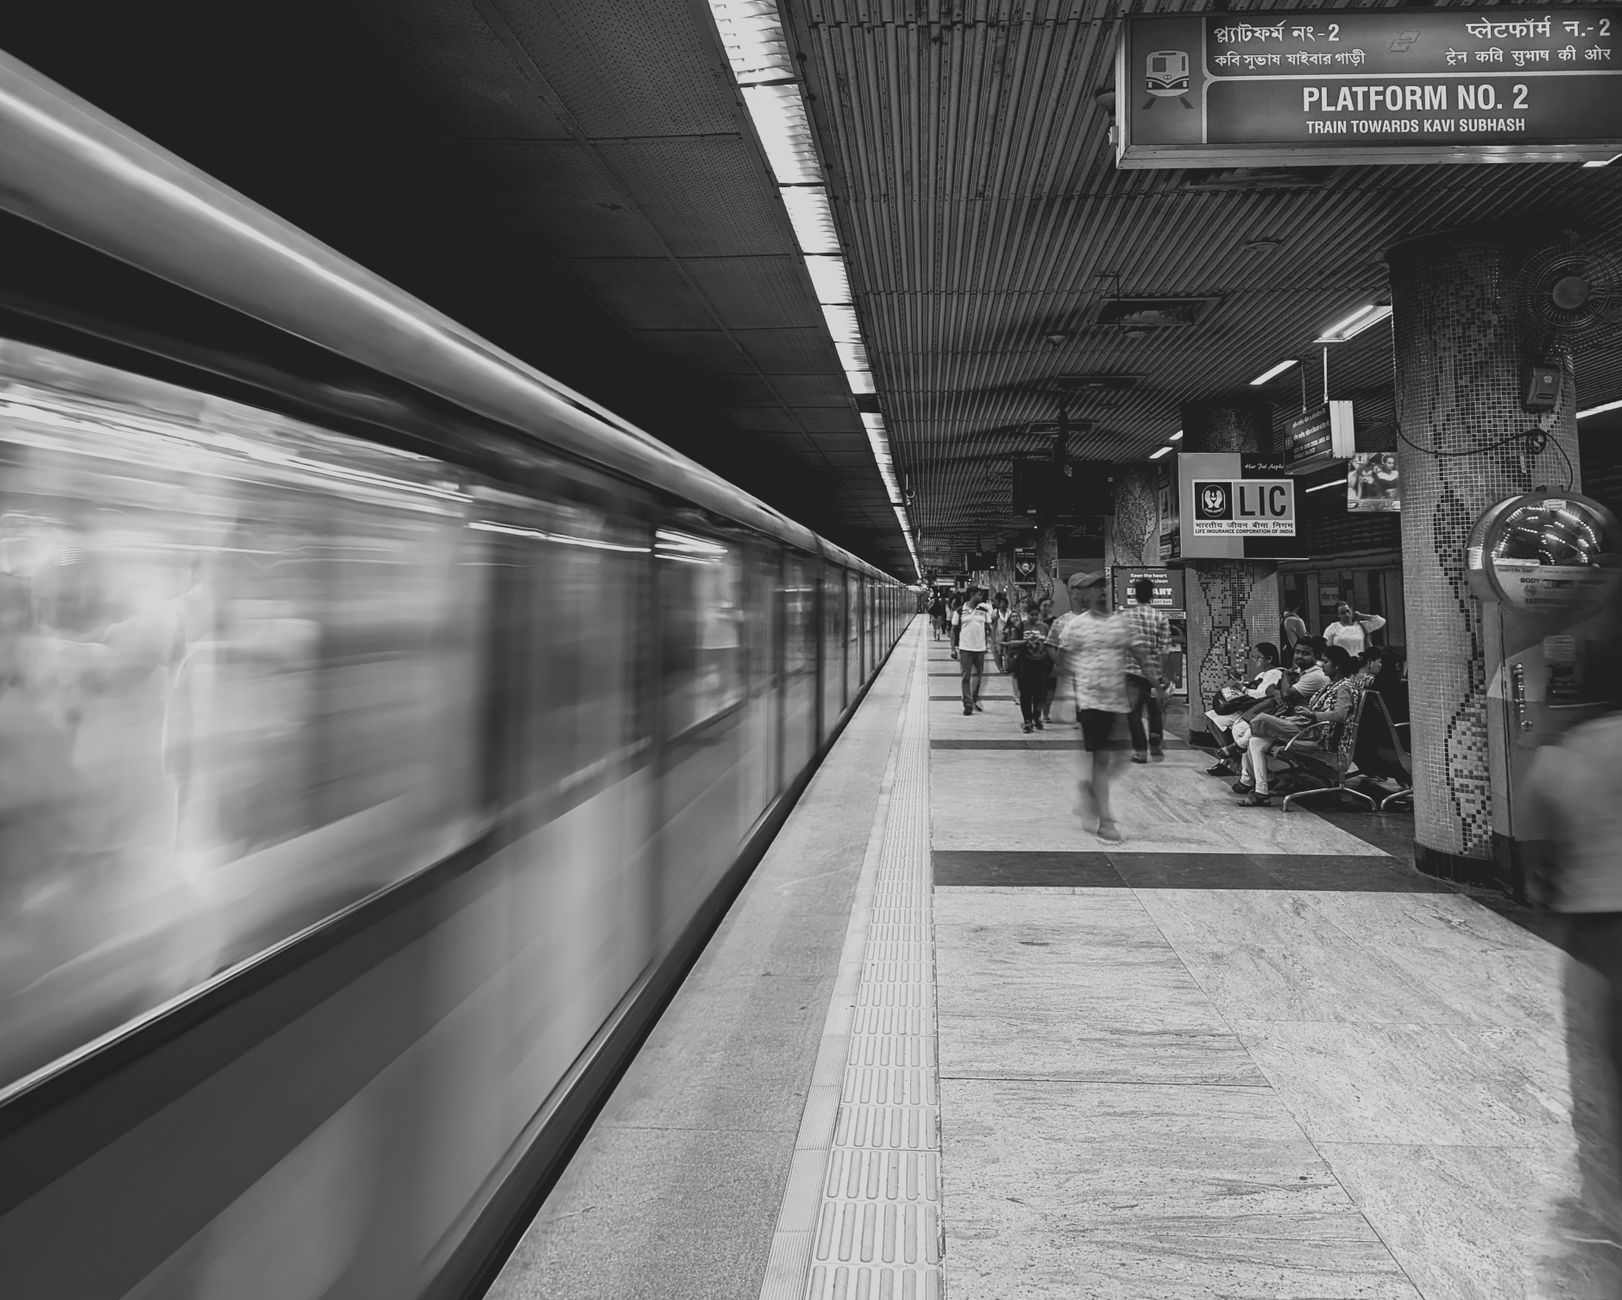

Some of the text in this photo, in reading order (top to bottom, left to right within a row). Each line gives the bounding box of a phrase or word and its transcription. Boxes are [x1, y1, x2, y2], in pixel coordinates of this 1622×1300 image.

[1465, 15, 1551, 39] प्लेटफॉर्म
[1214, 50, 1241, 67] কবি
[1243, 53, 1282, 70] সুভাষ
[1286, 51, 1333, 66] যাইবার
[1445, 44, 1611, 67] ट्रेन कवि सुभाष की ओर
[1303, 84, 1529, 112] PLATFORM NO. 2
[1306, 118, 1525, 134] TRAIN TOWARDS KAVI SUBHASH
[1239, 485, 1286, 517] LIC
